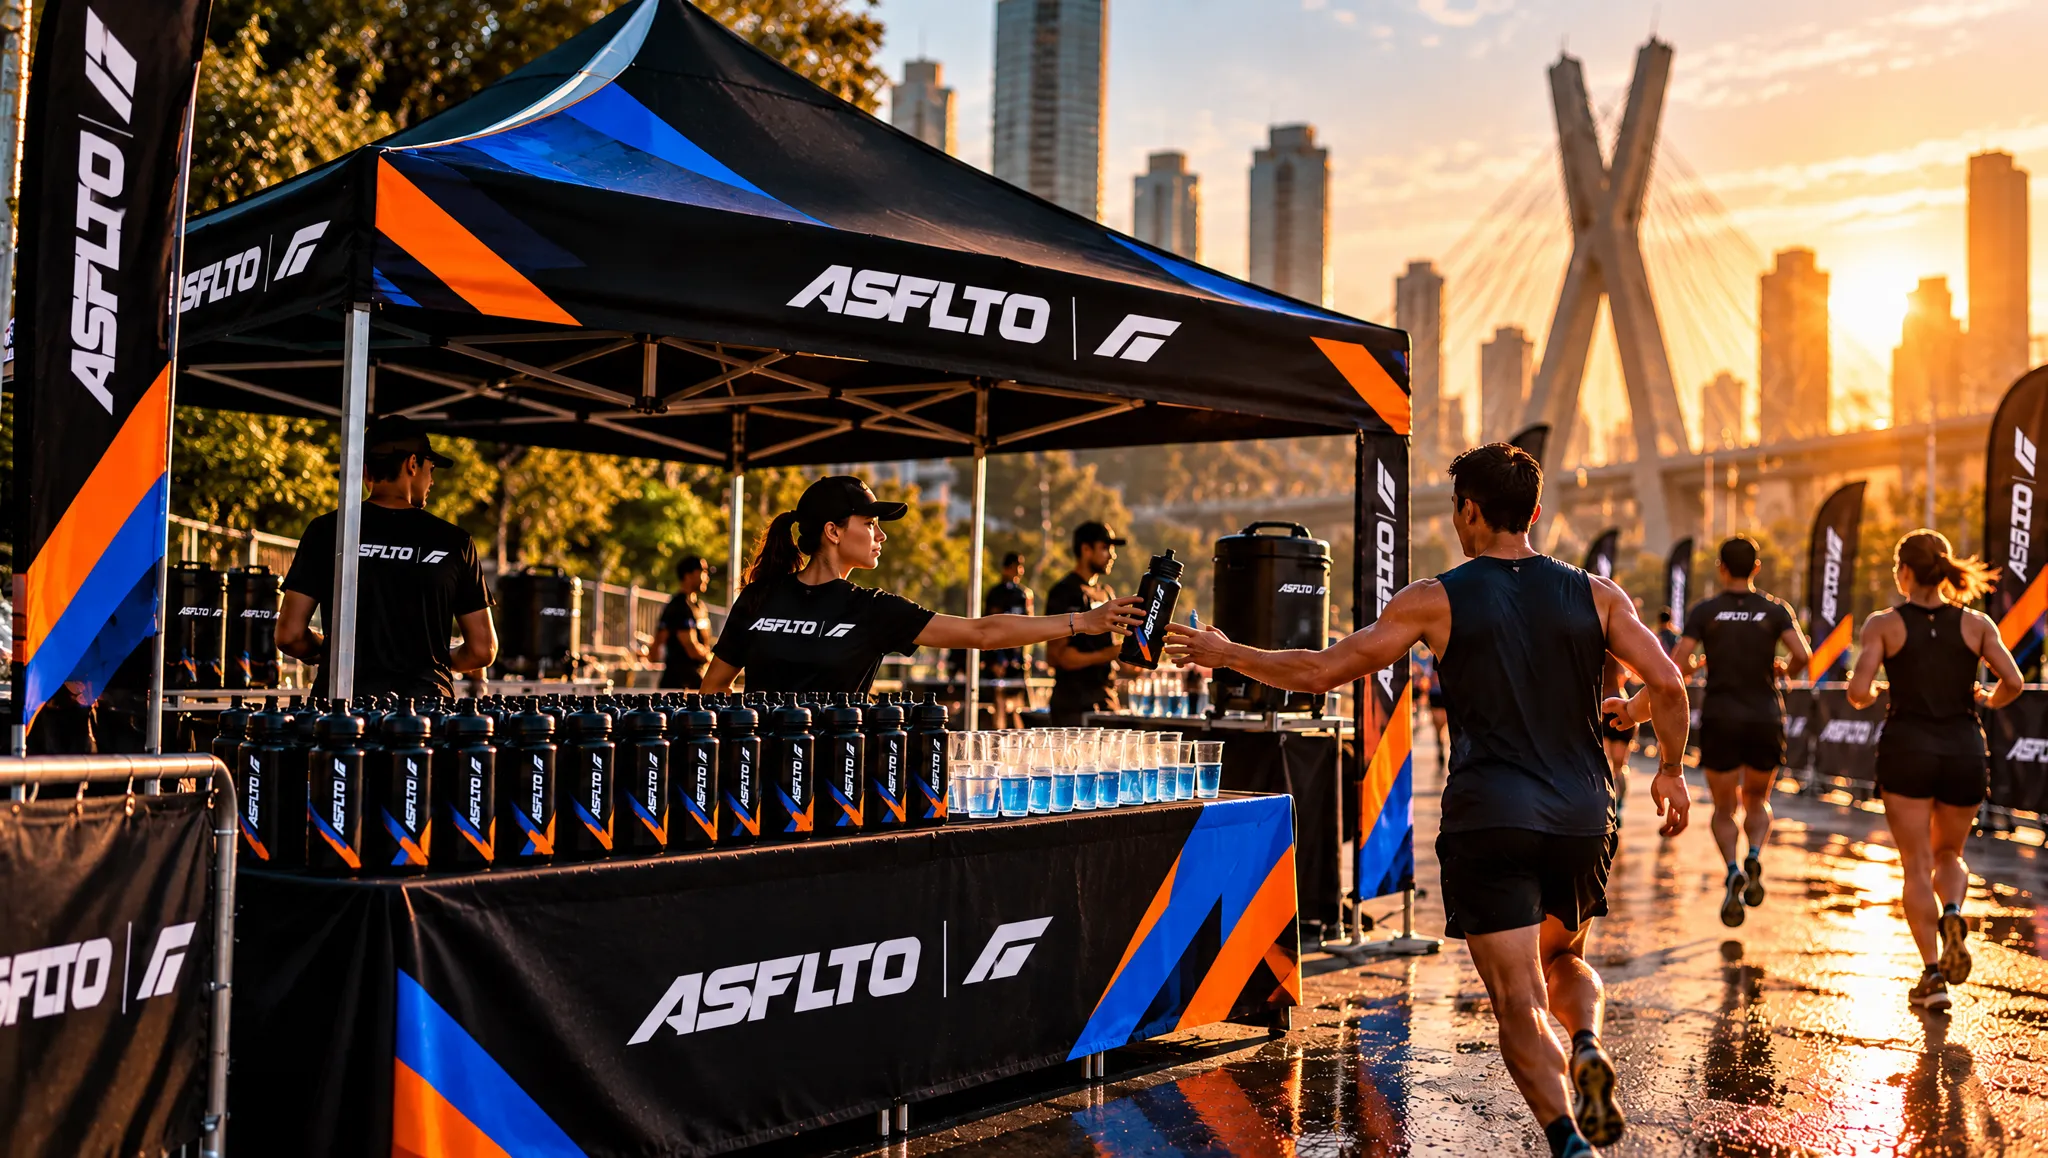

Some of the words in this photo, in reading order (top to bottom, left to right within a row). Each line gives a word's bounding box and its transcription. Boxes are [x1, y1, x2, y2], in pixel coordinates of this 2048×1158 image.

[71, 129, 126, 416] ASFLTO
[179, 246, 262, 314] SFLTO
[786, 264, 1051, 344] ASFLTO
[358, 543, 414, 561] SFLTO
[178, 607, 209, 616] ASFLTO
[1278, 583, 1313, 594] ASFLTO
[240, 609, 270, 619] ASFLTO
[748, 617, 818, 635] ASFLTO
[1143, 599, 1161, 640] ASFLTO
[591, 772, 602, 819] ASFLTO
[647, 770, 658, 816] ASFLTO
[696, 766, 707, 812] ASFLTO
[740, 763, 750, 809] ASFLTO
[791, 761, 803, 805] ASFLTO
[844, 757, 855, 800] ASFLTO
[887, 755, 897, 797] ASFLTO
[931, 752, 941, 794] ASFLTO
[248, 776, 260, 829] ASFLTO
[332, 780, 346, 835] ASFLTO
[405, 778, 417, 833] ASFLTO
[470, 777, 481, 829] ASFLTO
[532, 774, 543, 824] ASFLTO
[626, 936, 921, 1046] ASFLTO
